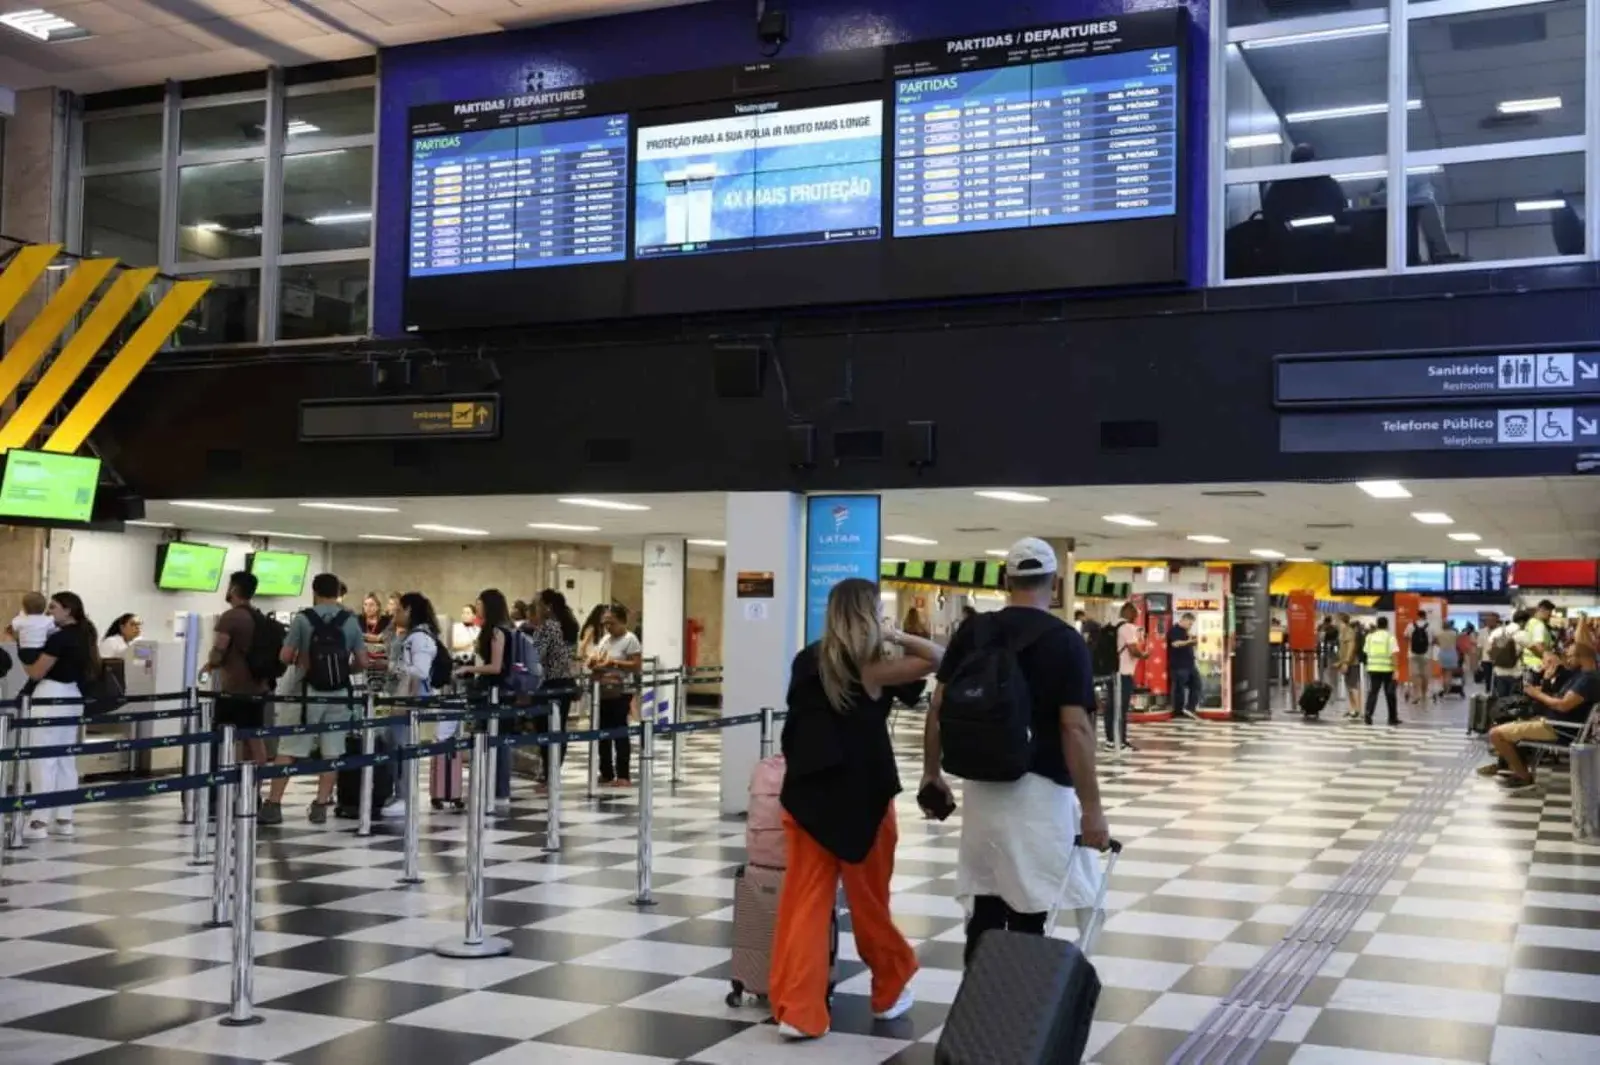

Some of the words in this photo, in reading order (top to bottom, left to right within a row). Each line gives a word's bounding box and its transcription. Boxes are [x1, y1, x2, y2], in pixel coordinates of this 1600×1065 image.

[947, 34, 1013, 53] PARTIDAS
[1024, 20, 1117, 44] DEPARTURES
[899, 77, 957, 94] PARTIDAS
[454, 98, 505, 115] PARTIDAS
[513, 88, 585, 108] DEPARTURES
[646, 135, 691, 151] PROTEÇÃO
[692, 132, 715, 145] PARA
[717, 132, 724, 142] A
[725, 128, 743, 142] SUA
[744, 126, 771, 140] FOLIA
[772, 126, 782, 136] IR
[783, 121, 813, 135] MUITO
[814, 119, 838, 132] MAIS
[840, 115, 870, 129] LONGE
[415, 136, 461, 150] PARTIDAS
[724, 190, 743, 208] 4X
[745, 187, 787, 206] MAIS
[790, 176, 871, 203] PROTEÇÃO
[1428, 363, 1495, 377] Sanitários
[1443, 380, 1494, 391] Restrooms
[1382, 420, 1439, 432] Telefone
[1443, 417, 1494, 431] Público
[1442, 435, 1494, 446] Telephone
[819, 533, 861, 544] LATAM
